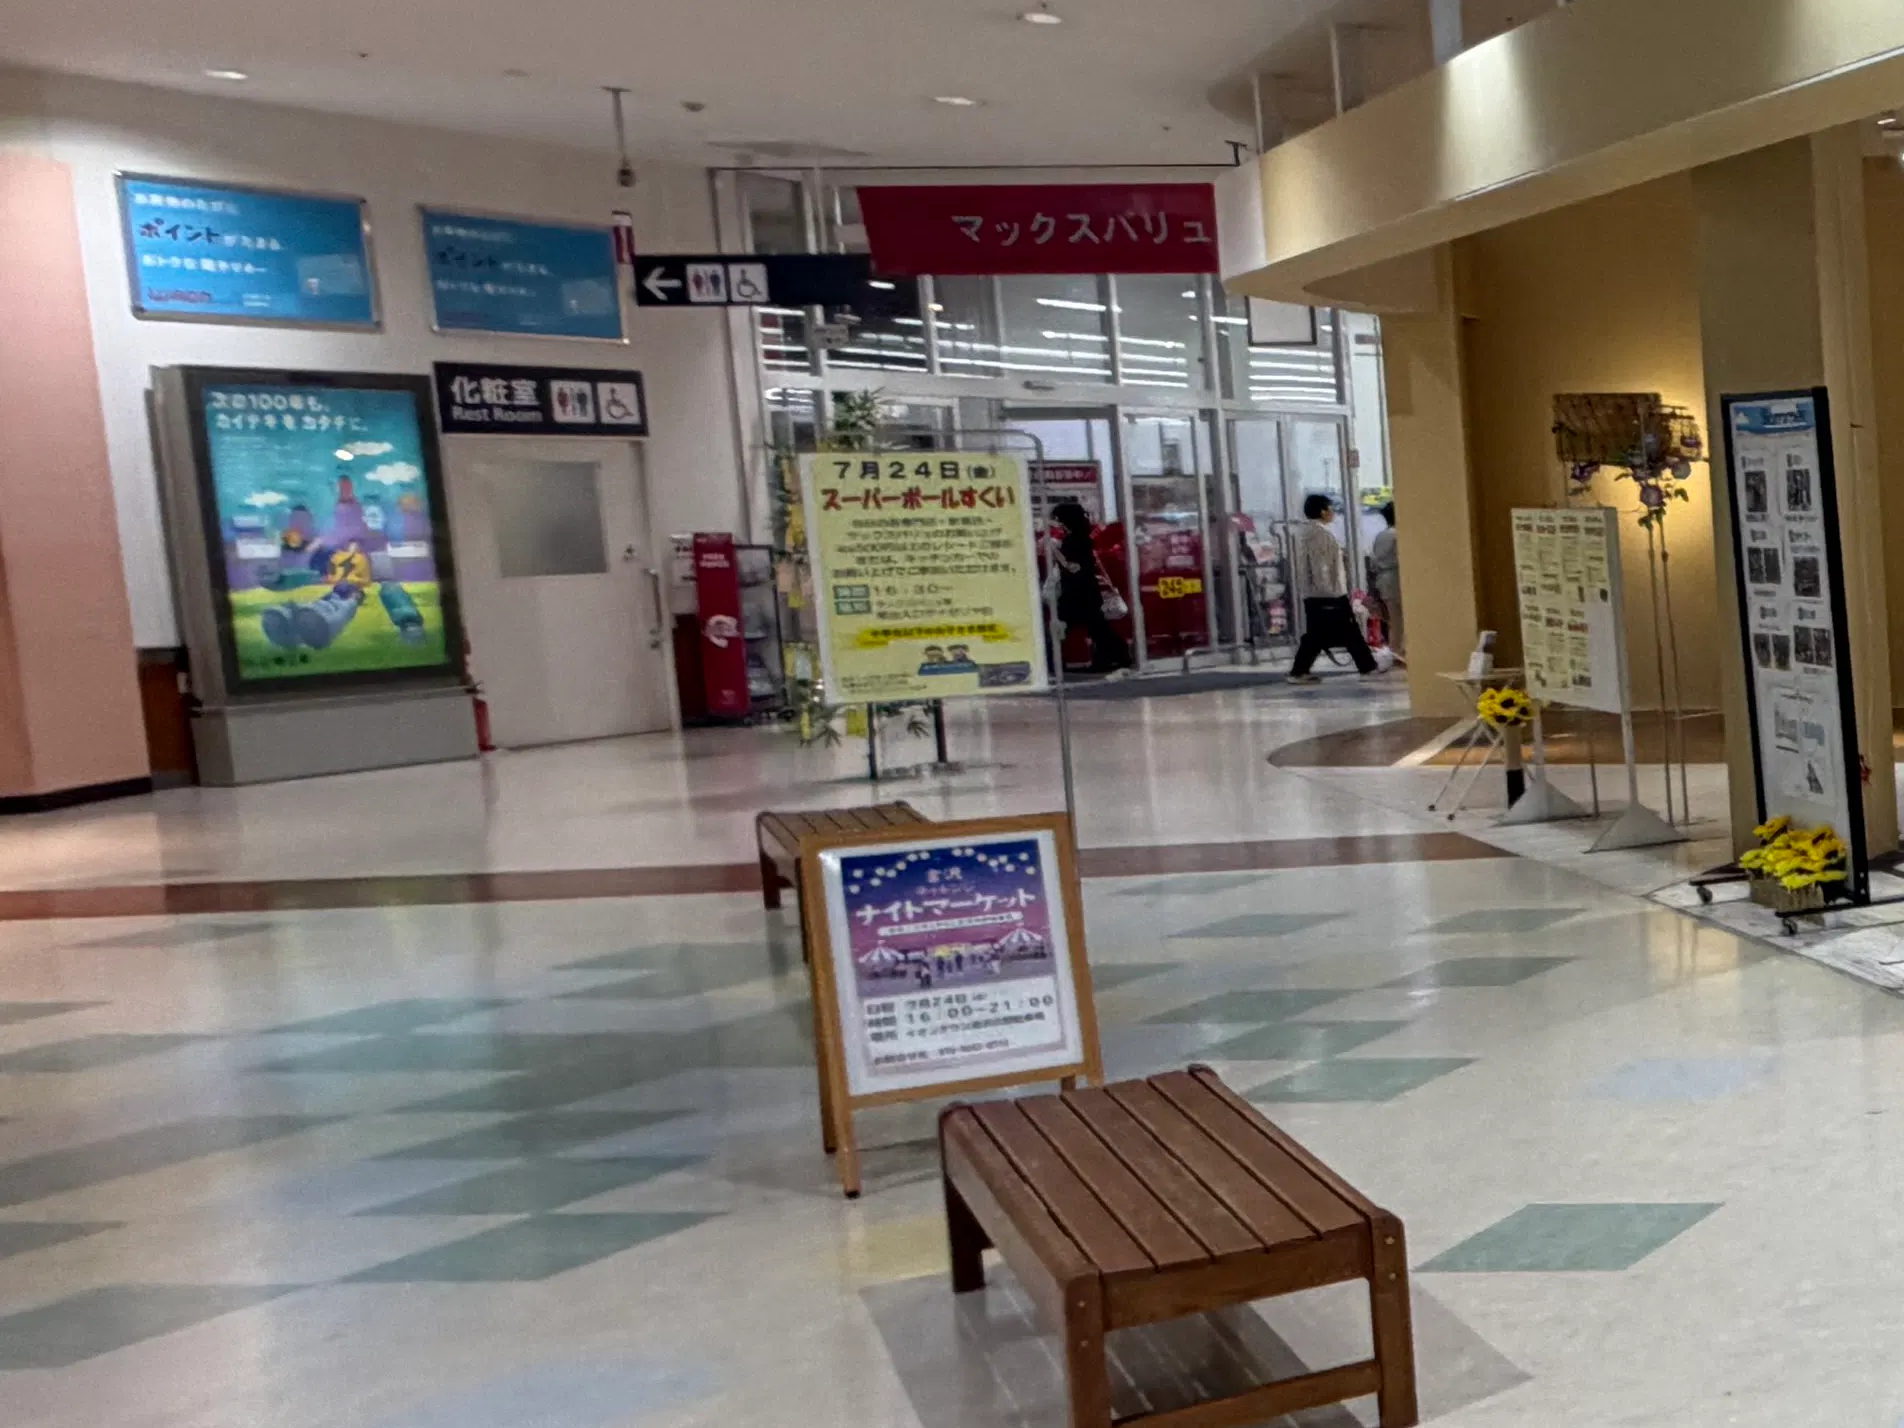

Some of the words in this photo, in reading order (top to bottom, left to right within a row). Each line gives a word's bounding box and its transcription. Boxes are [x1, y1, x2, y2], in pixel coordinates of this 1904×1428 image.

[139, 218, 220, 244] ポイント
[951, 211, 1212, 247] マックスバリュ
[451, 375, 541, 406] 化粧室
[820, 485, 1016, 511] スーパーボールすくい
[855, 888, 1037, 926] ナイトマーケット
